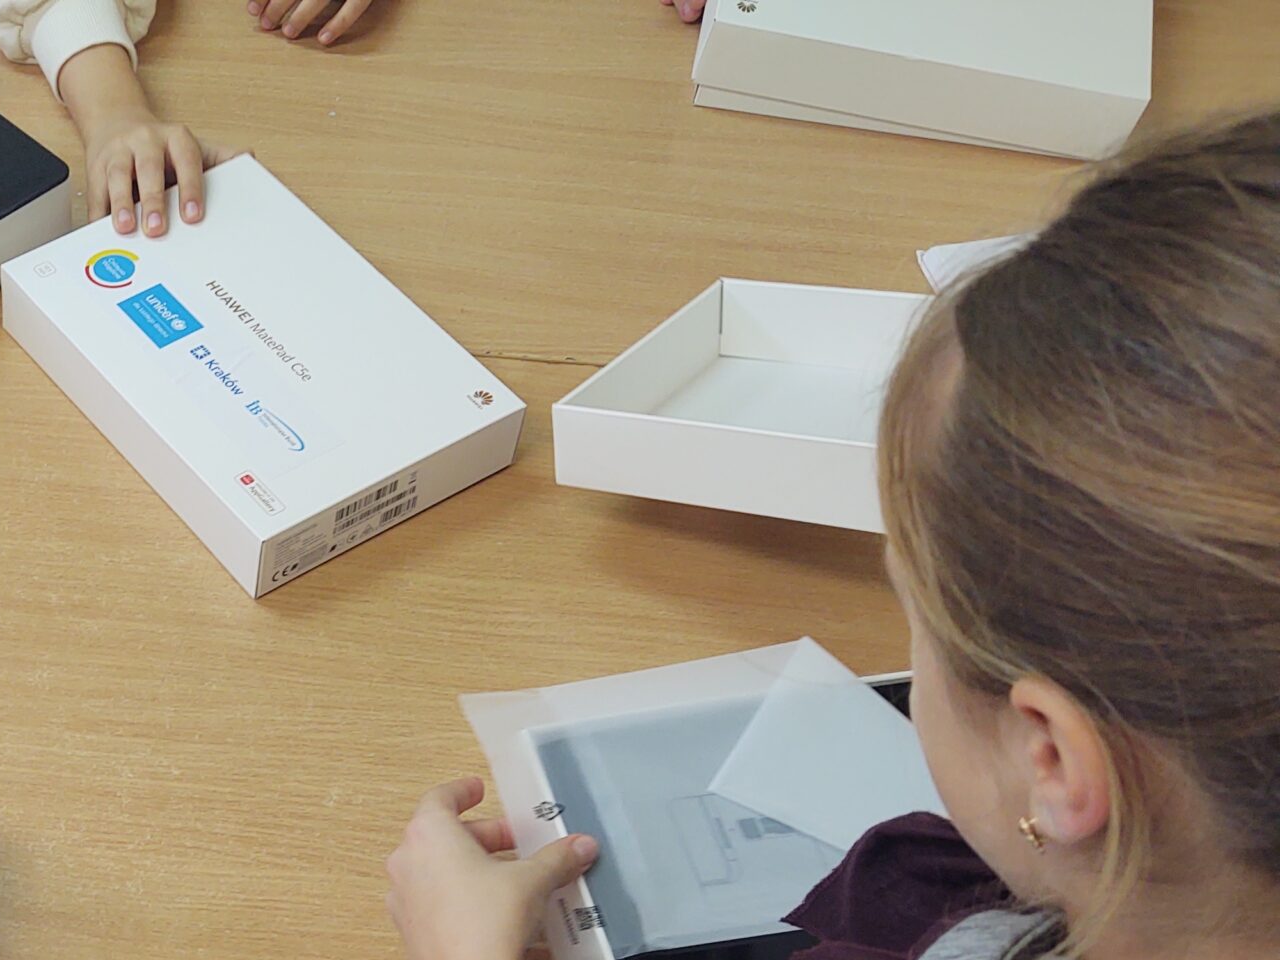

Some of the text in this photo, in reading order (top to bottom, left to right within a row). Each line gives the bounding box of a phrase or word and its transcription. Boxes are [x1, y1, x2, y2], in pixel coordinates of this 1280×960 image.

[145, 293, 179, 322] unicef
[205, 279, 312, 383] HUAWEI MatePad C5e
[204, 358, 244, 396] Kraków
